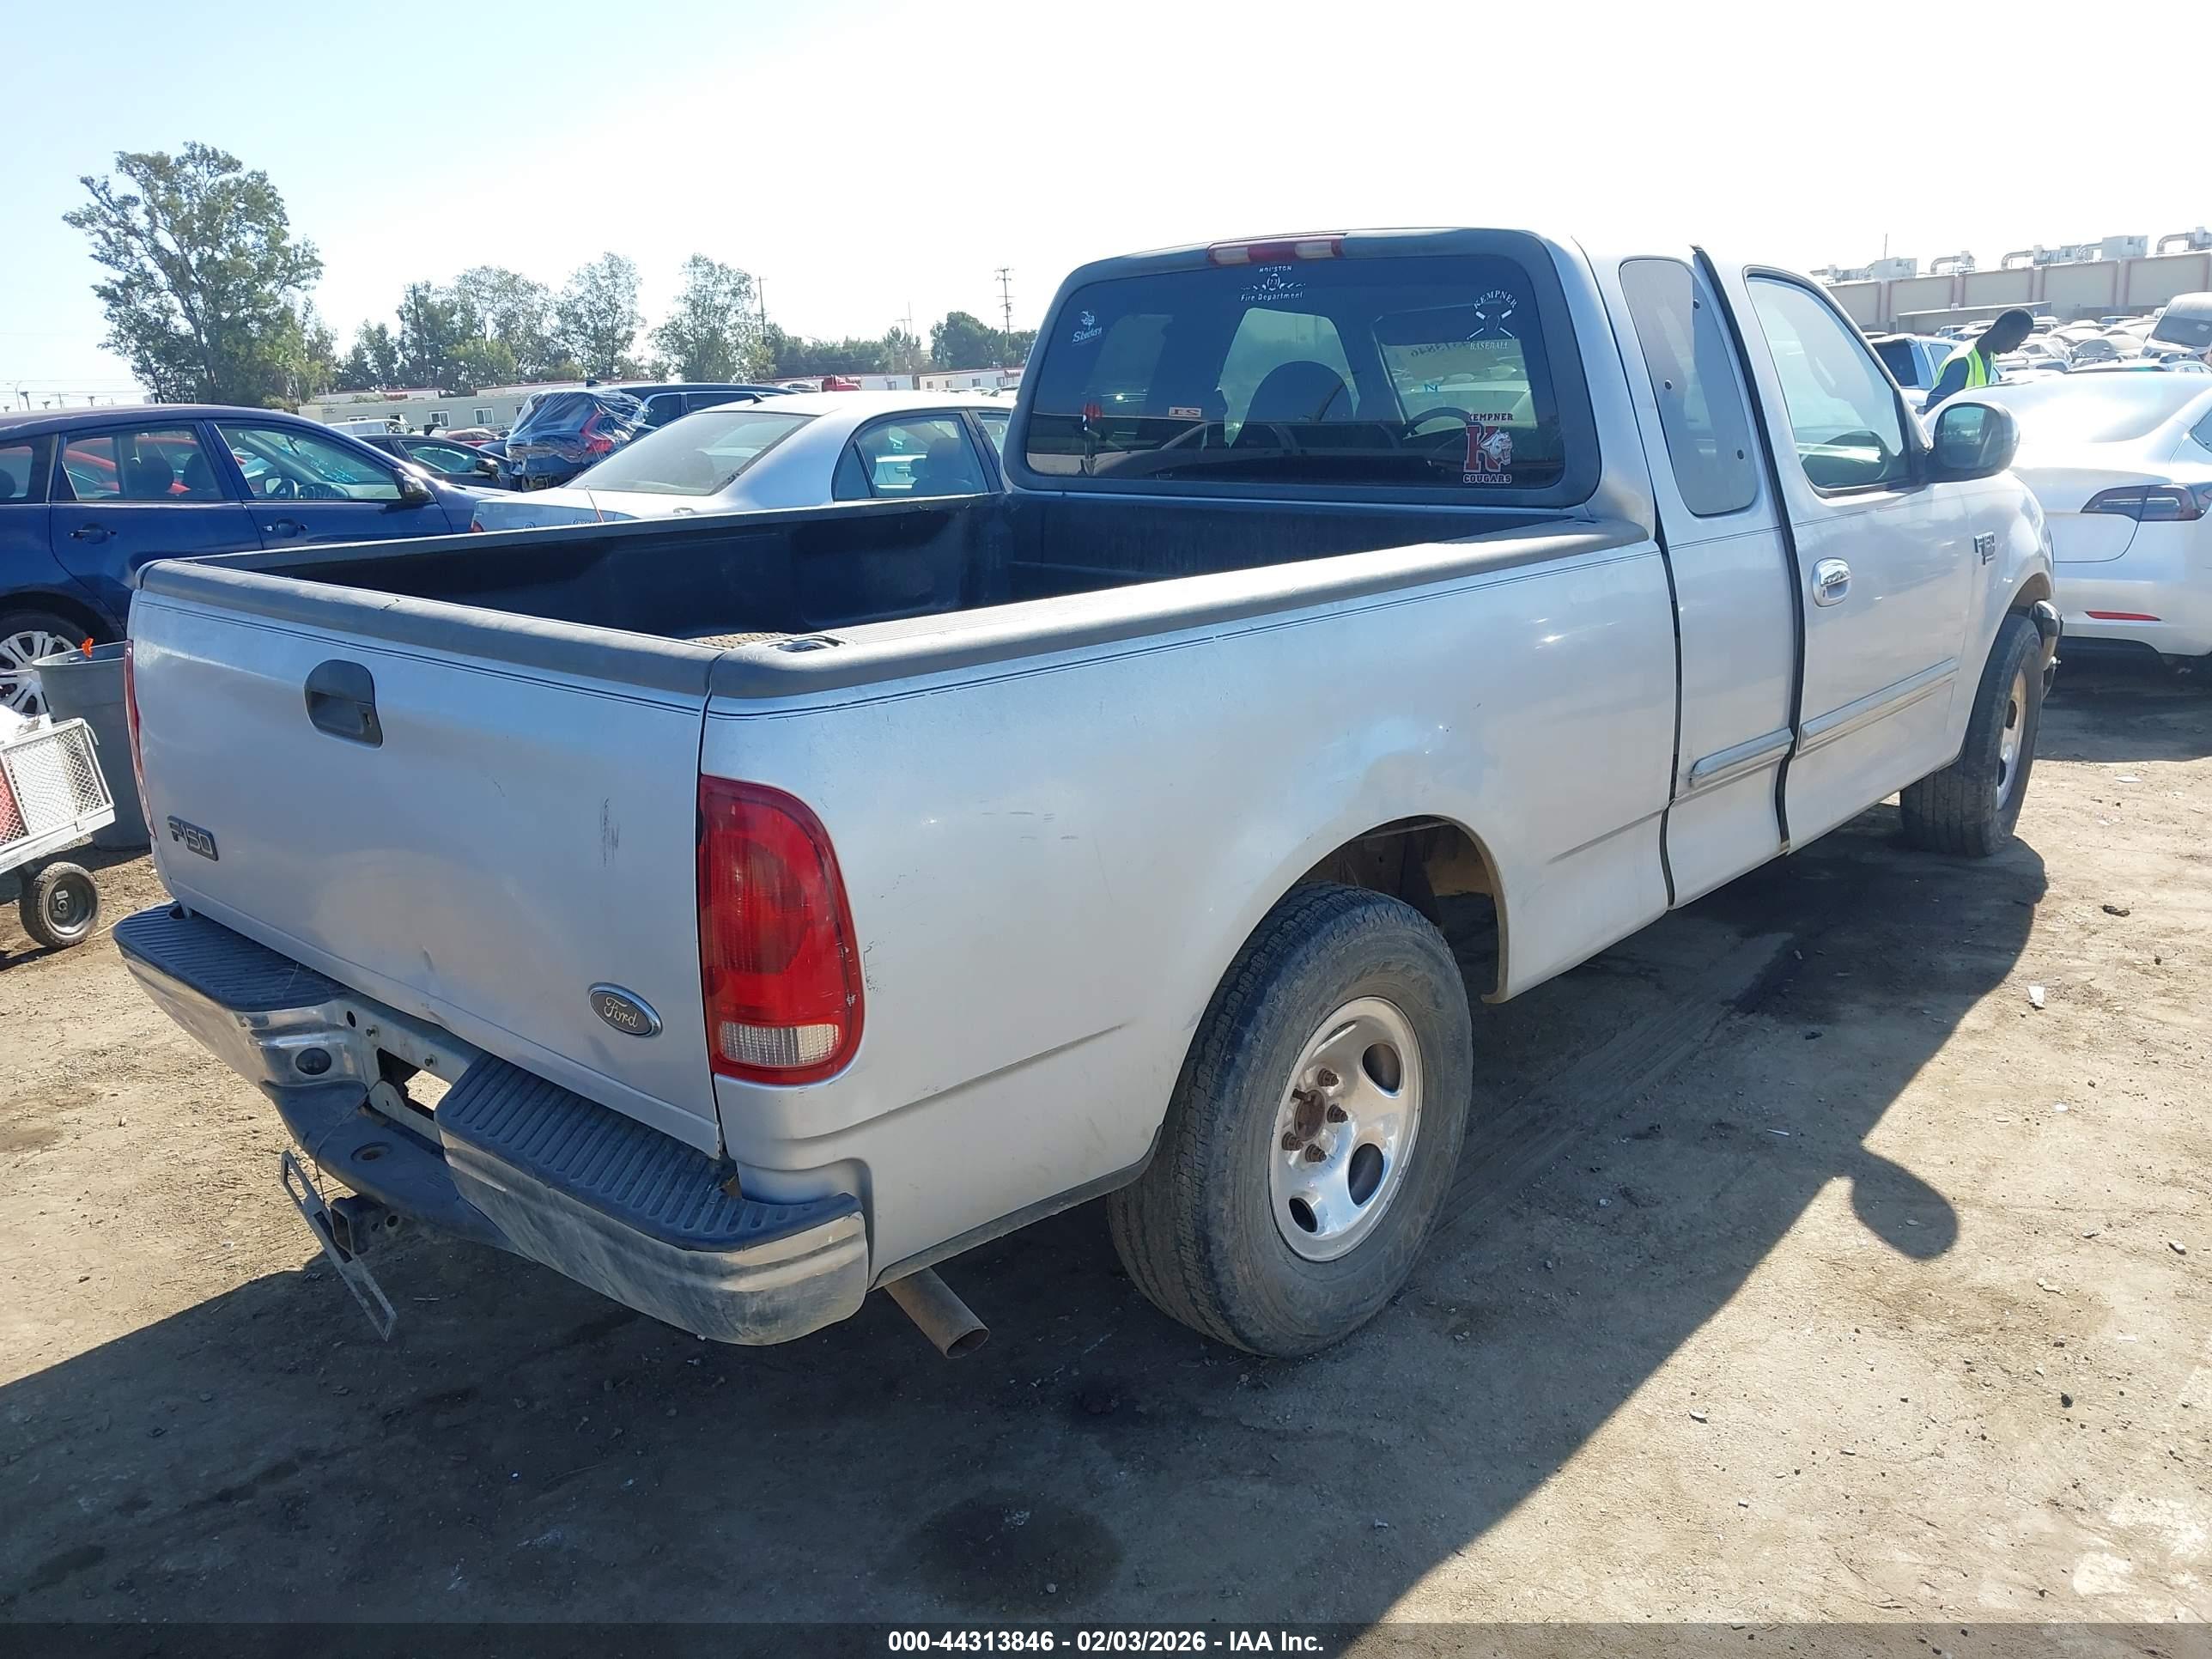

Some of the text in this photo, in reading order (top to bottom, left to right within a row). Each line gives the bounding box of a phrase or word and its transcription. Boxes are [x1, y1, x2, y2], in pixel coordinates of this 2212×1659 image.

[1258, 291, 1303, 301] Department
[1474, 289, 1517, 309] KEMPNER
[1469, 341, 1508, 350] BASEBALL
[1462, 473, 1512, 484] COUGARS
[604, 997, 638, 1028] Ford
